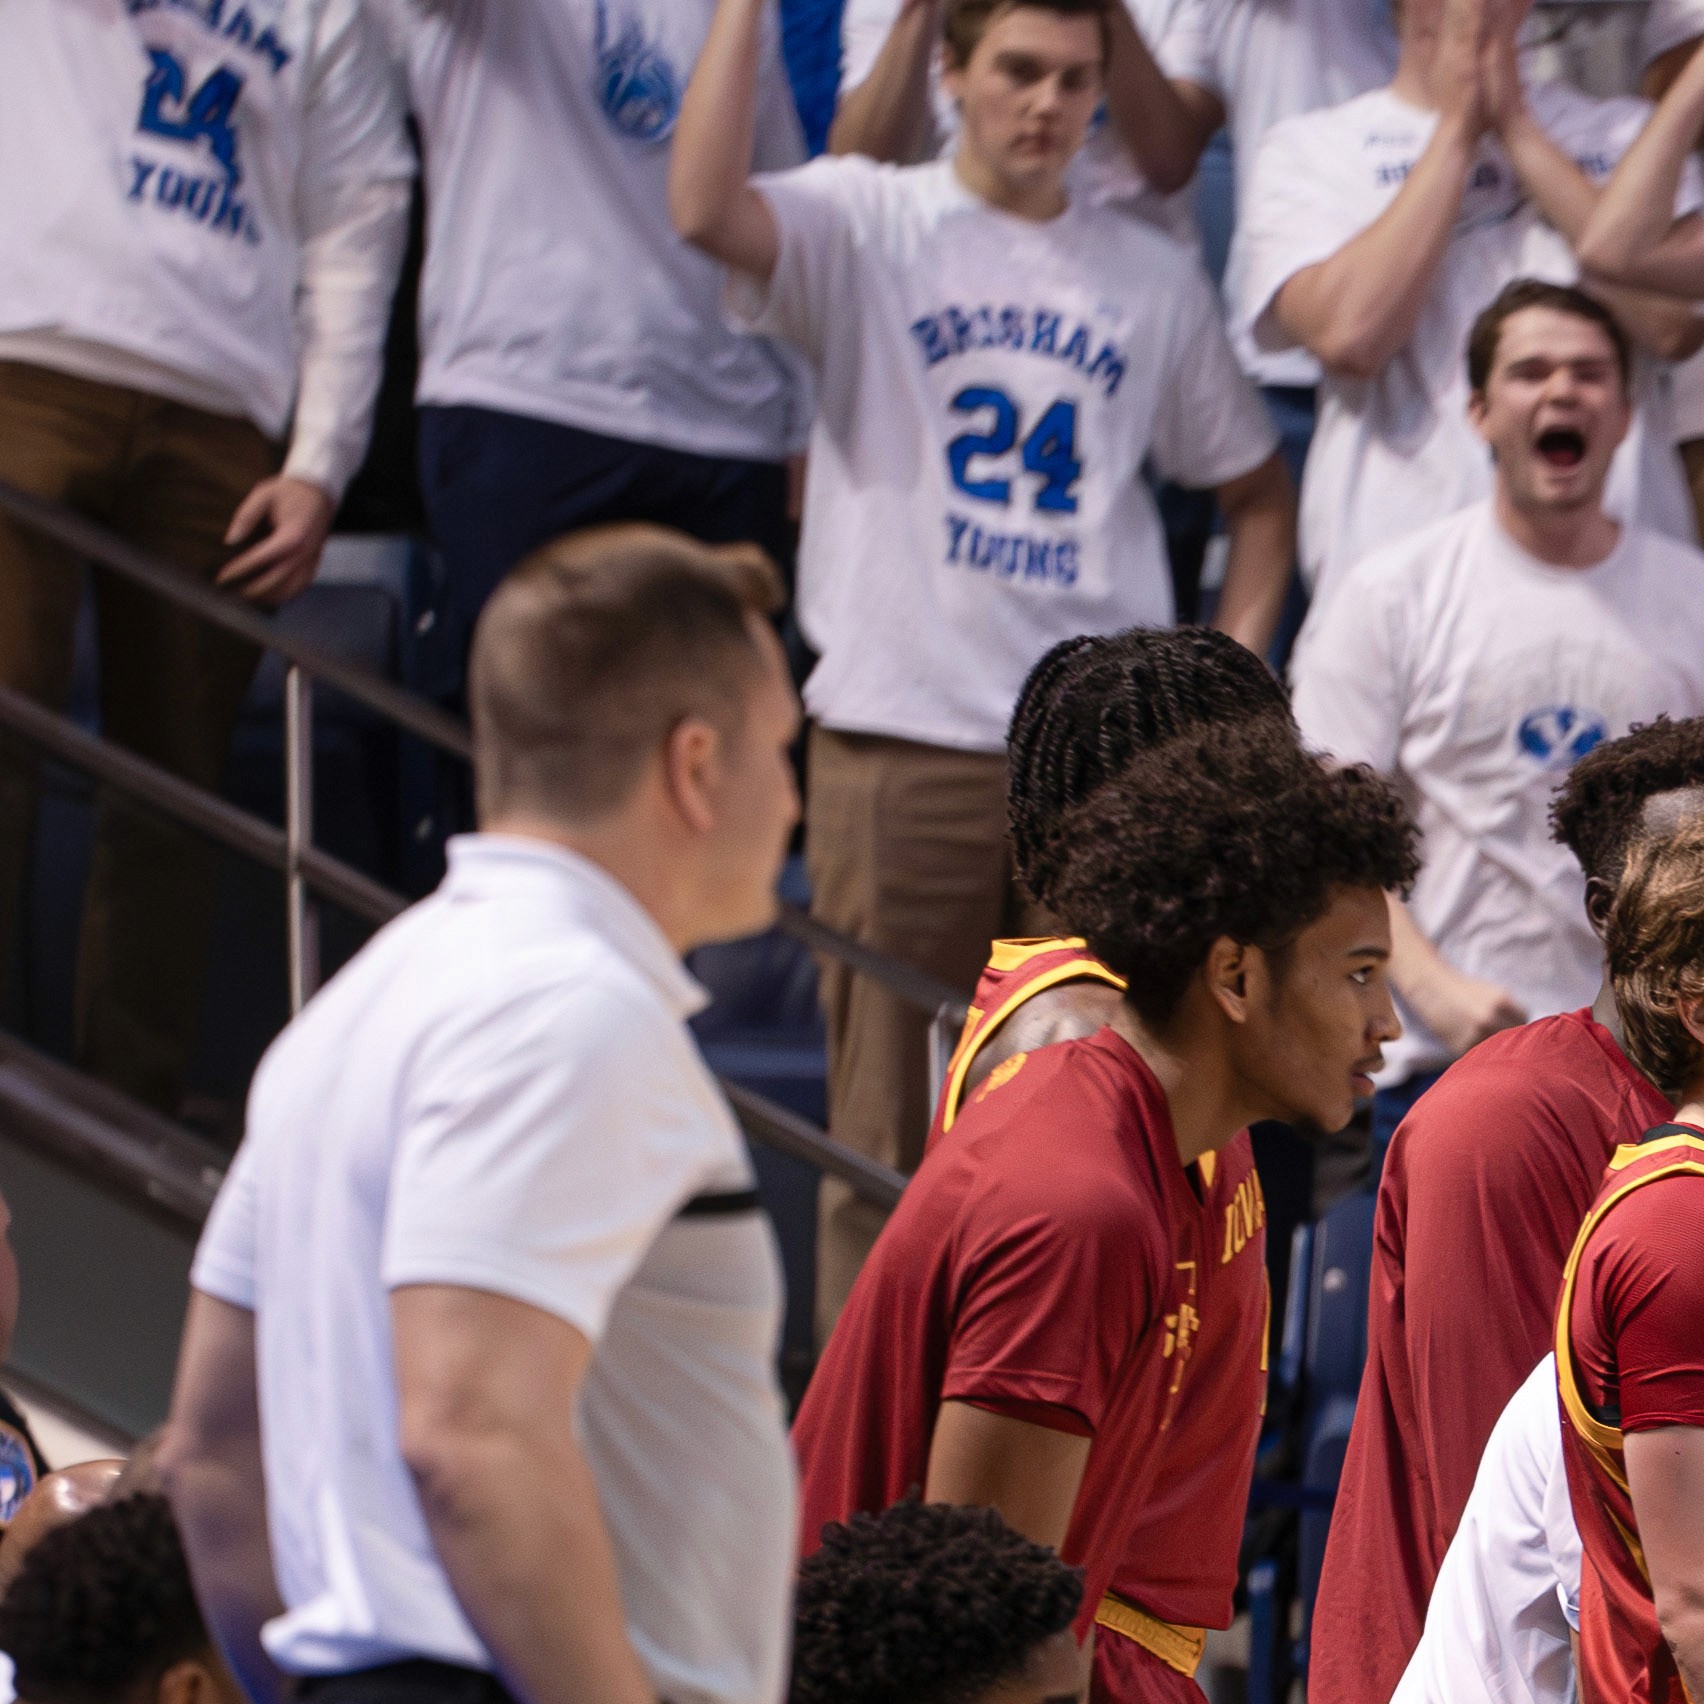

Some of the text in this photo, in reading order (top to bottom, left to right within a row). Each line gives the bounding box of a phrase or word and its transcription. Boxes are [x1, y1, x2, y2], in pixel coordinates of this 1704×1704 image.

[138, 47, 245, 190] 24
[909, 304, 1128, 399] BRIGHAM
[946, 386, 1081, 513] 24
[944, 512, 1081, 584] YOUNG
